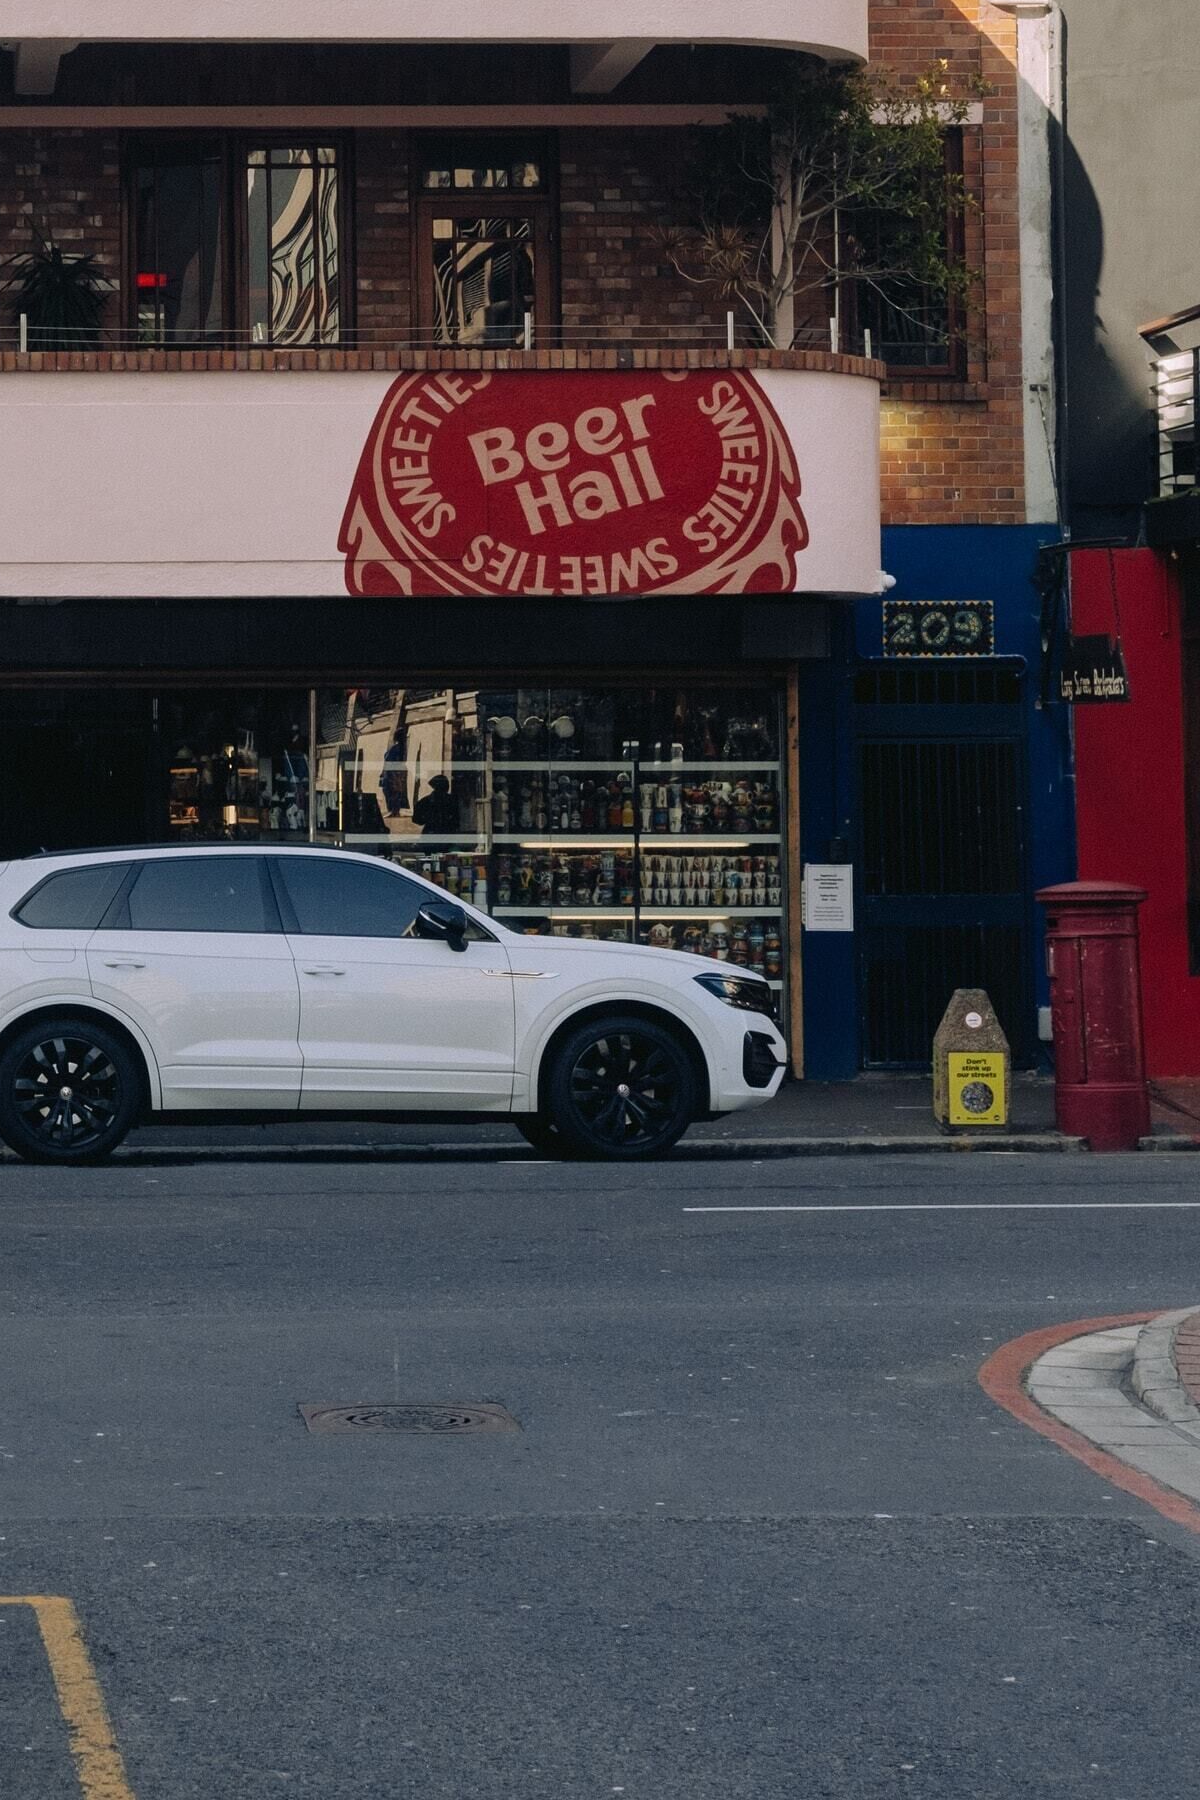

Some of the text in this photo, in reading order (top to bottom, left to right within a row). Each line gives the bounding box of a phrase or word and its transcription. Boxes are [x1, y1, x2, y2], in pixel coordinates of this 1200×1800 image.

[467, 394, 657, 486] Beer
[682, 380, 760, 553] SWEETIES
[514, 445, 666, 536] Hall
[462, 534, 679, 596] SWEETIES
[890, 611, 982, 644] 209
